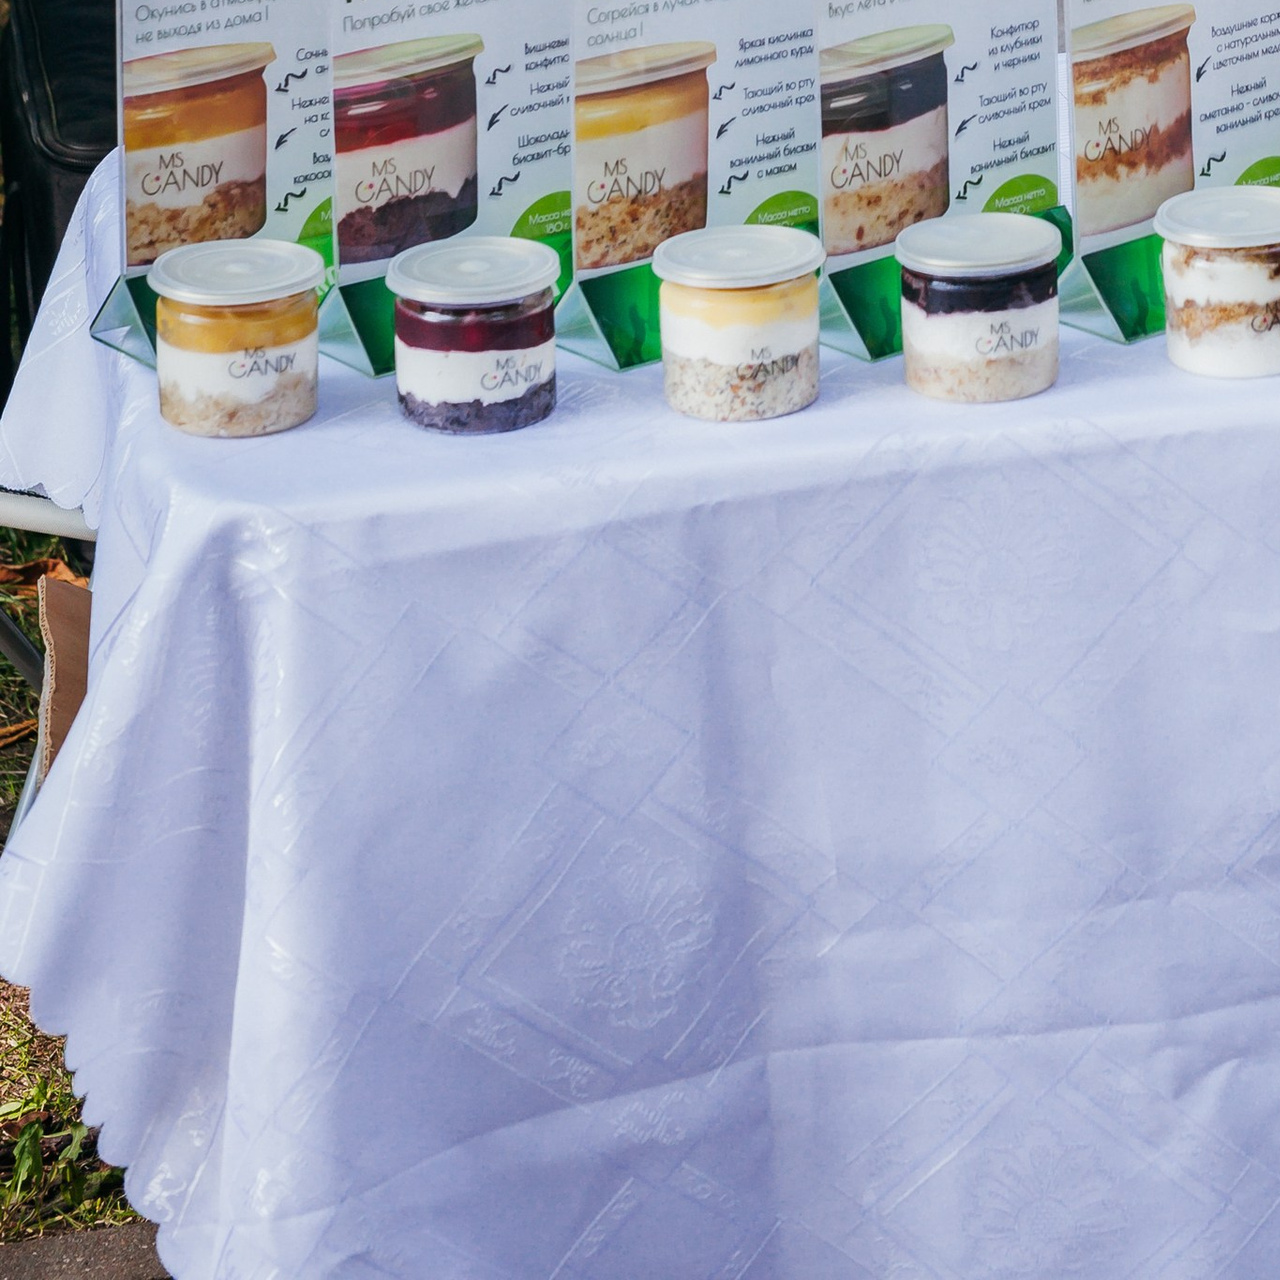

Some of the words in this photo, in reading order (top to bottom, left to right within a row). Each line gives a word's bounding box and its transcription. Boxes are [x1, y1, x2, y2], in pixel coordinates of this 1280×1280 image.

[135, 3, 196, 22] Окунись
[343, 4, 415, 32] Попробуй
[419, 0, 450, 16] свое
[587, 2, 651, 25] Согрейся
[828, 0, 854, 19] Вкус
[136, 30, 153, 43] не
[157, 23, 202, 40] выходя
[206, 20, 220, 30] из
[990, 19, 1040, 40] Конфитюр
[1211, 17, 1259, 38] Воздушные
[1000, 35, 1043, 55] клубники
[734, 50, 789, 69] лимонного
[1001, 52, 1041, 71] черники
[1212, 51, 1260, 71] цветочным
[1230, 76, 1267, 97] Нежный
[742, 96, 793, 117] сливочный
[977, 102, 1027, 125] сливочный
[1215, 110, 1263, 134] ванильный
[993, 131, 1030, 151] Нежный
[729, 146, 782, 169] ванильный
[970, 151, 1018, 175] ванильный
